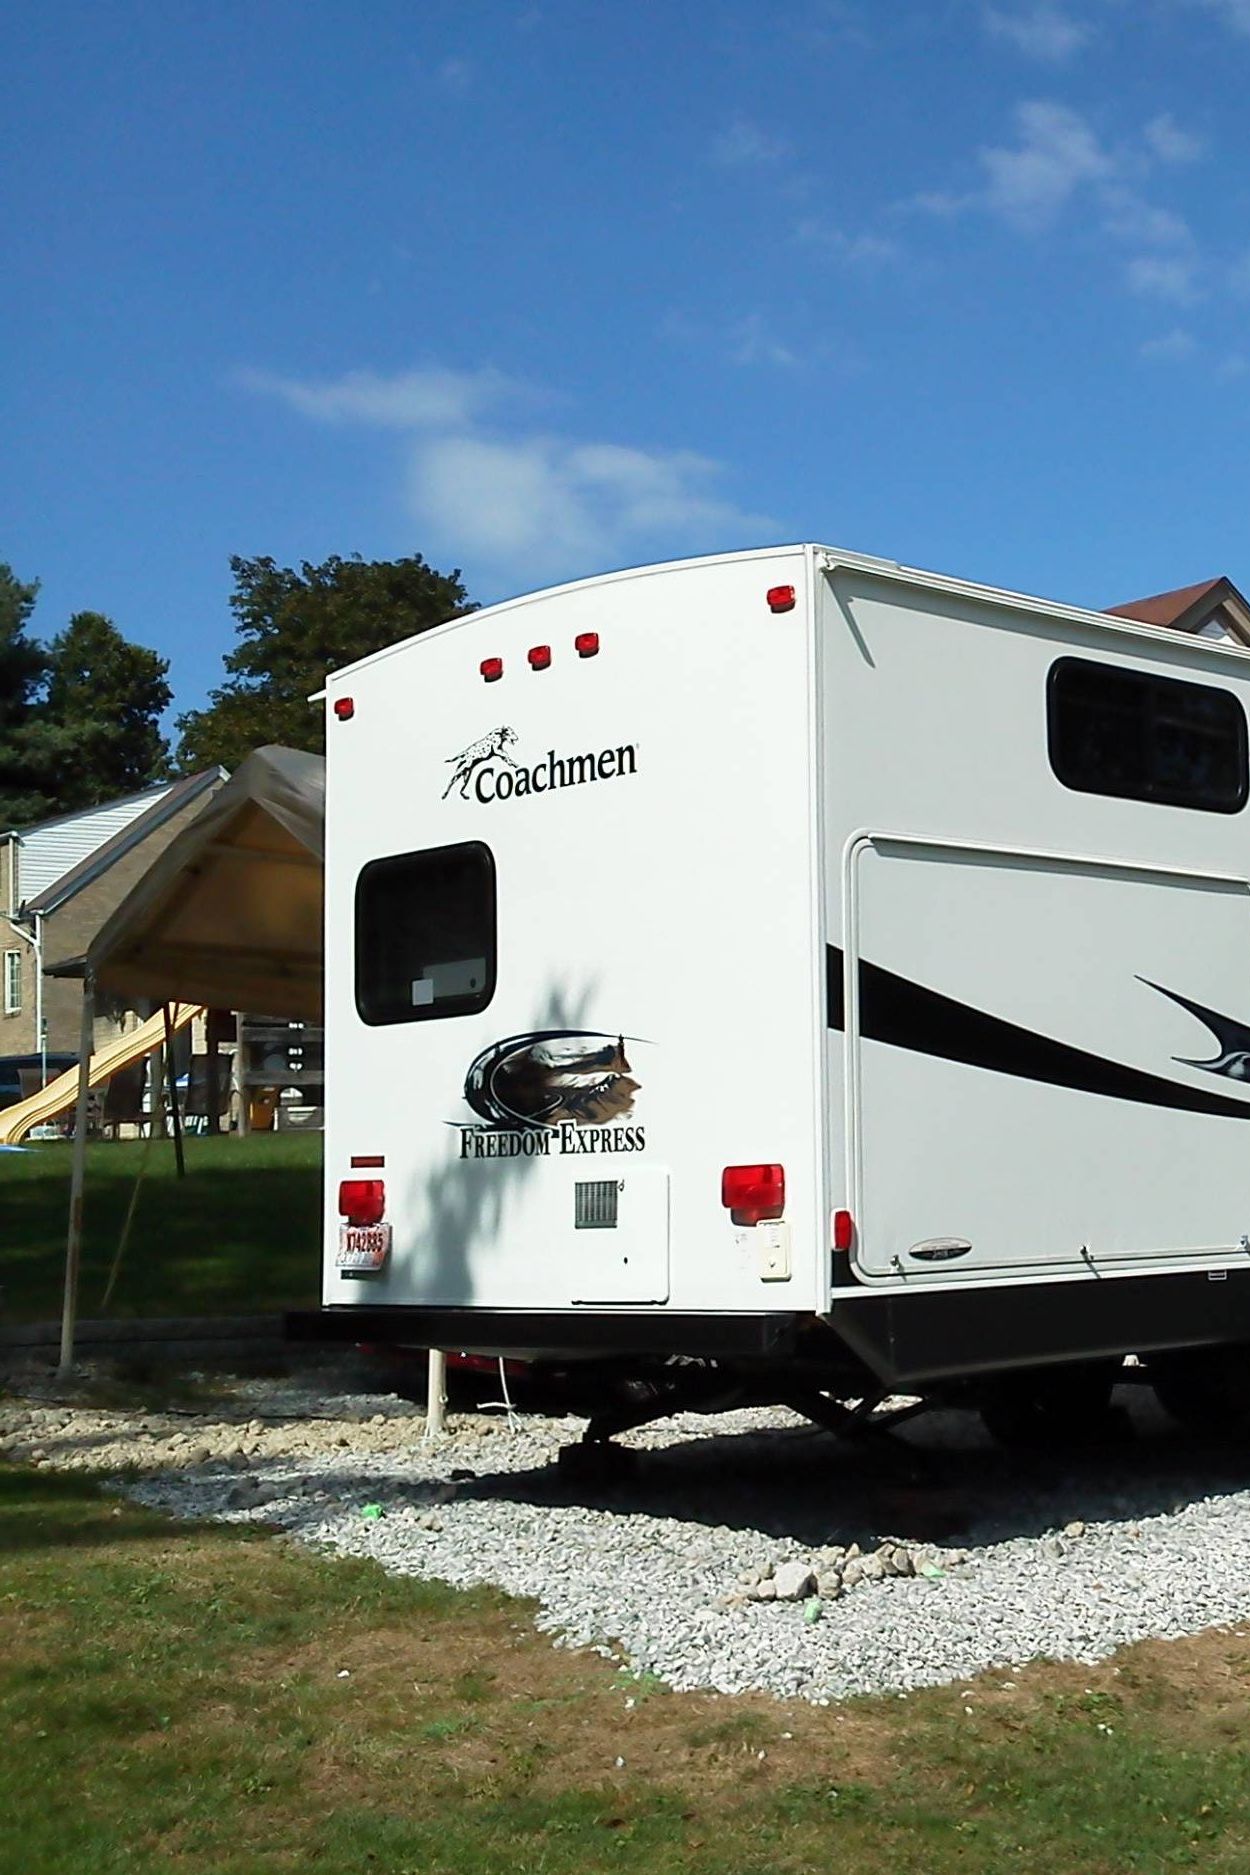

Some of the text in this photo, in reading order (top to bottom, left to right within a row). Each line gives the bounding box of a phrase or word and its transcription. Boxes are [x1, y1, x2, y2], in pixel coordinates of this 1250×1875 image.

[475, 743, 638, 804] Coachmen
[459, 1122, 646, 1159] FREEDOM EXPRESS
